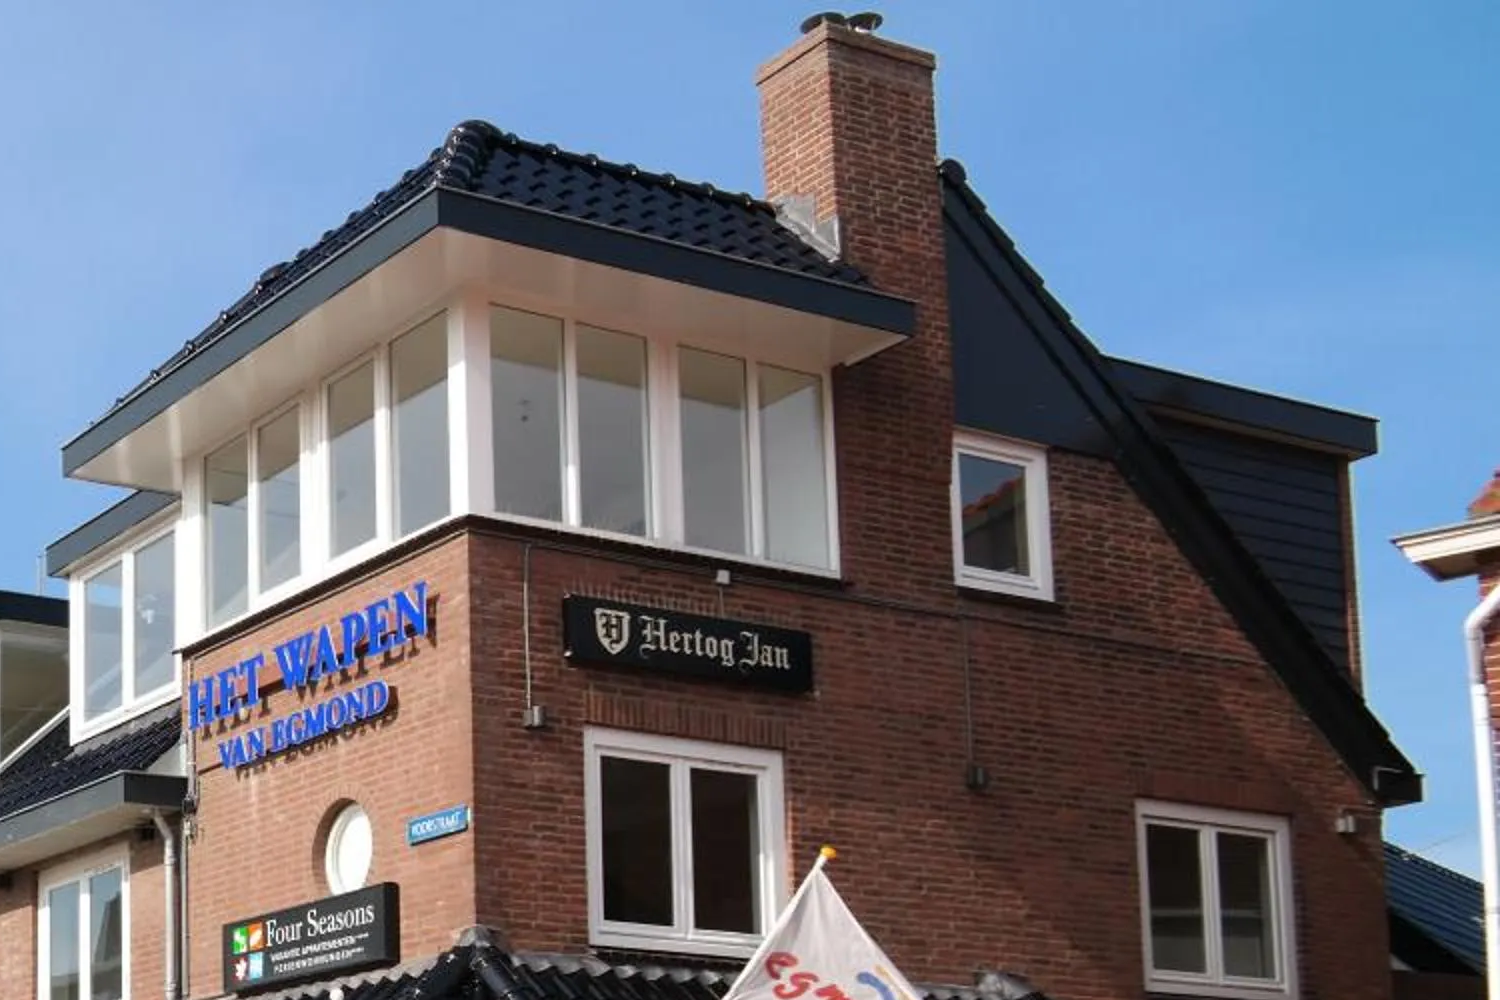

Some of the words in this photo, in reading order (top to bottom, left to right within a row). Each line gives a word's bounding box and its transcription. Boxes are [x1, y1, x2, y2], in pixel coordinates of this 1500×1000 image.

[189, 652, 264, 730] HET
[274, 581, 428, 690] WAPEN
[639, 615, 735, 667] Hertog
[739, 631, 792, 670] Jan
[218, 727, 267, 769] VAN
[271, 679, 390, 751] EGMOND
[265, 918, 303, 947] Four
[307, 903, 376, 938] Seasons
